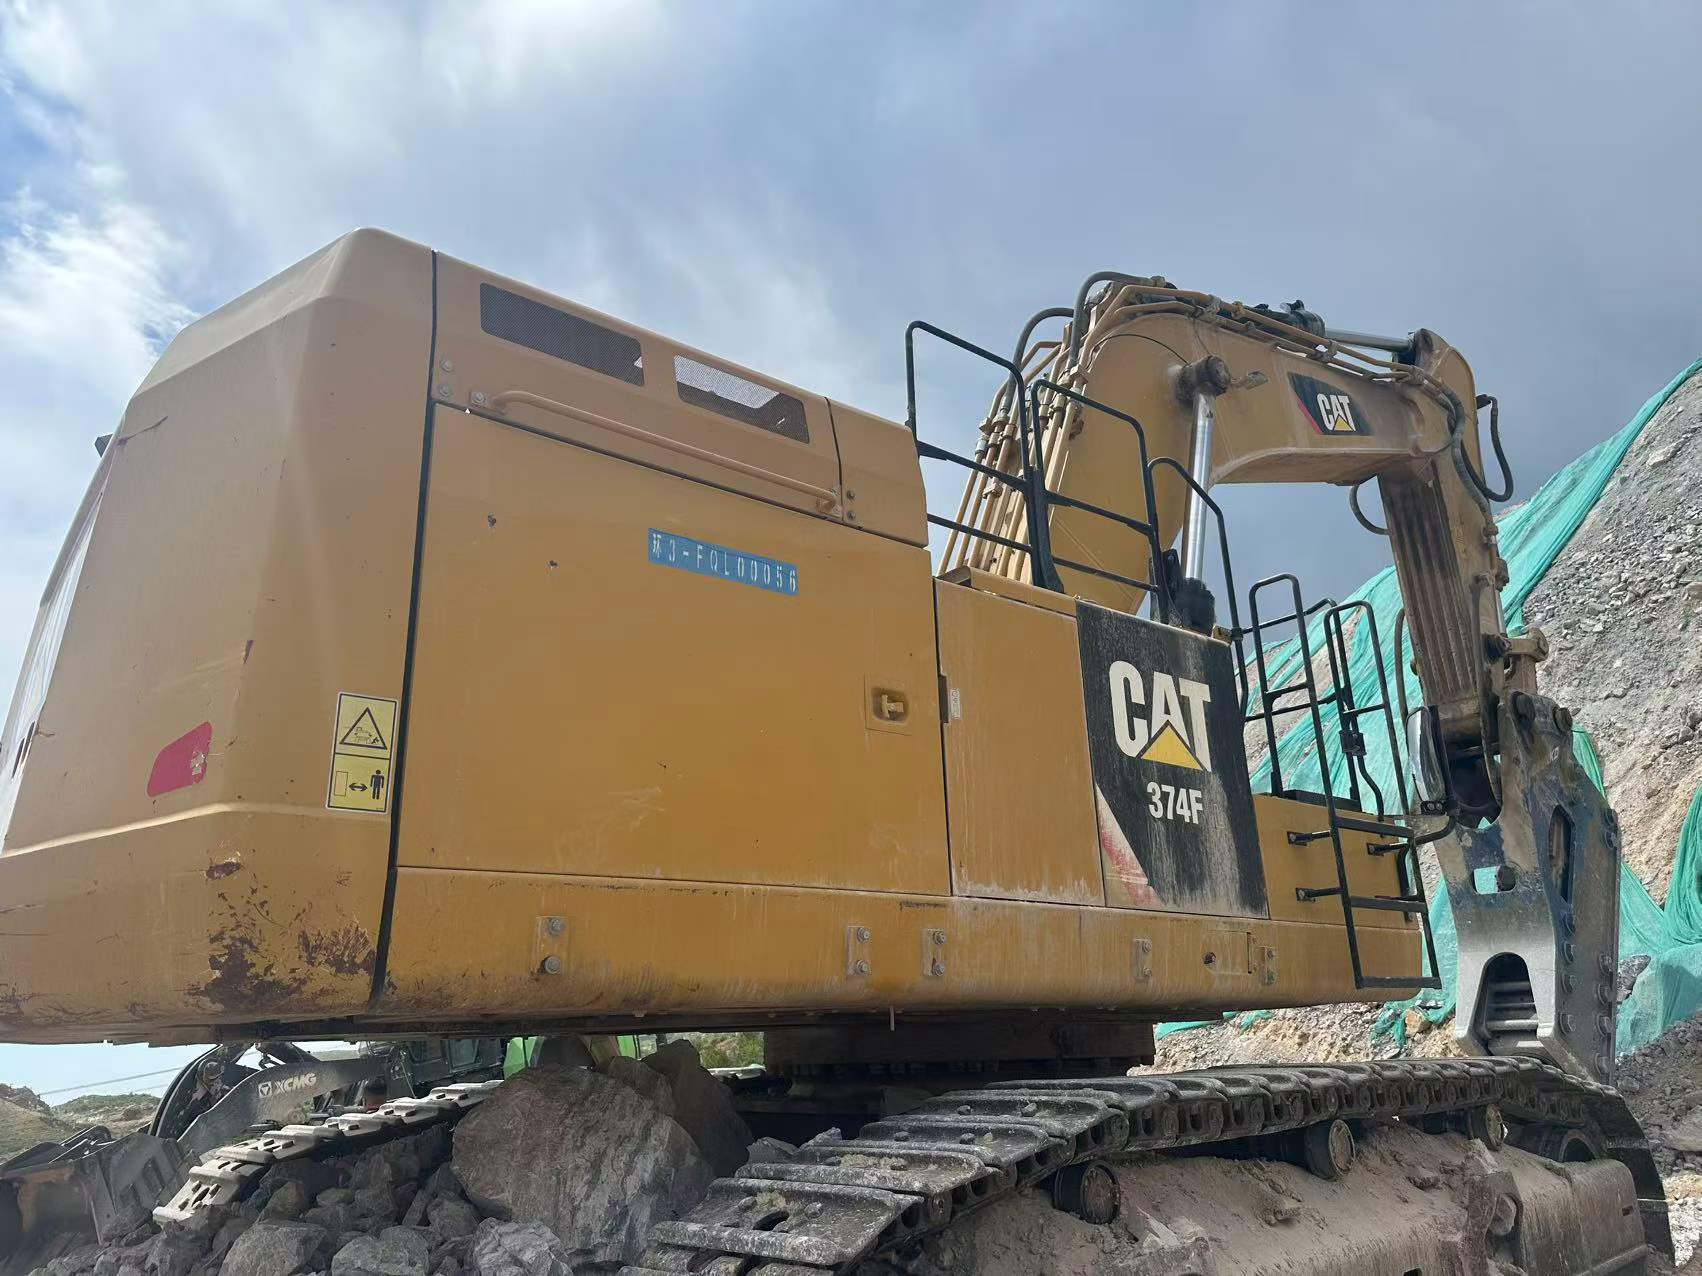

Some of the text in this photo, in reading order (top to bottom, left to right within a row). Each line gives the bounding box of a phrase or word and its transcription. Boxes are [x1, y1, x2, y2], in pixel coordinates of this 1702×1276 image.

[1316, 393, 1356, 432] CAT
[1109, 660, 1212, 772] CAT
[1146, 781, 1203, 825] 374F
[275, 1072, 317, 1094] XCMG
